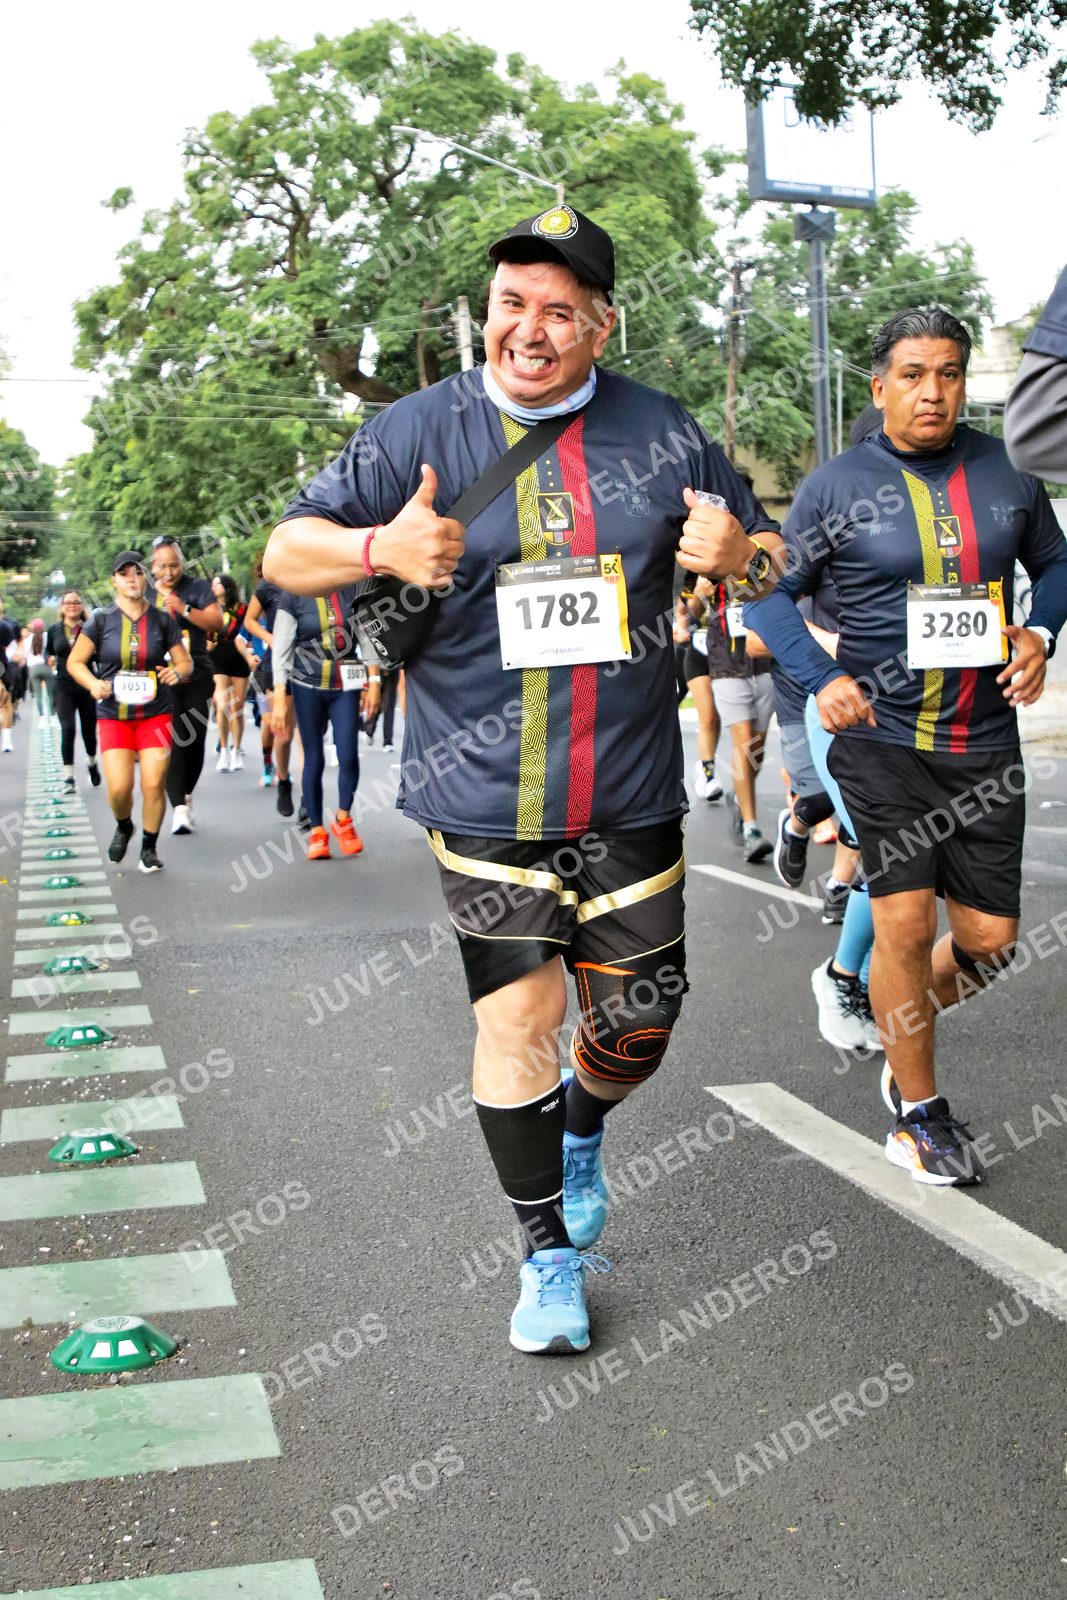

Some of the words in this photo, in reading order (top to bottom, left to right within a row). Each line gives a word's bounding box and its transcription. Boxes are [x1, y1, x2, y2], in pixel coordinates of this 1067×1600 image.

[603, 562, 618, 575] 5K
[515, 591, 600, 630] 1782
[922, 610, 987, 638] 3280
